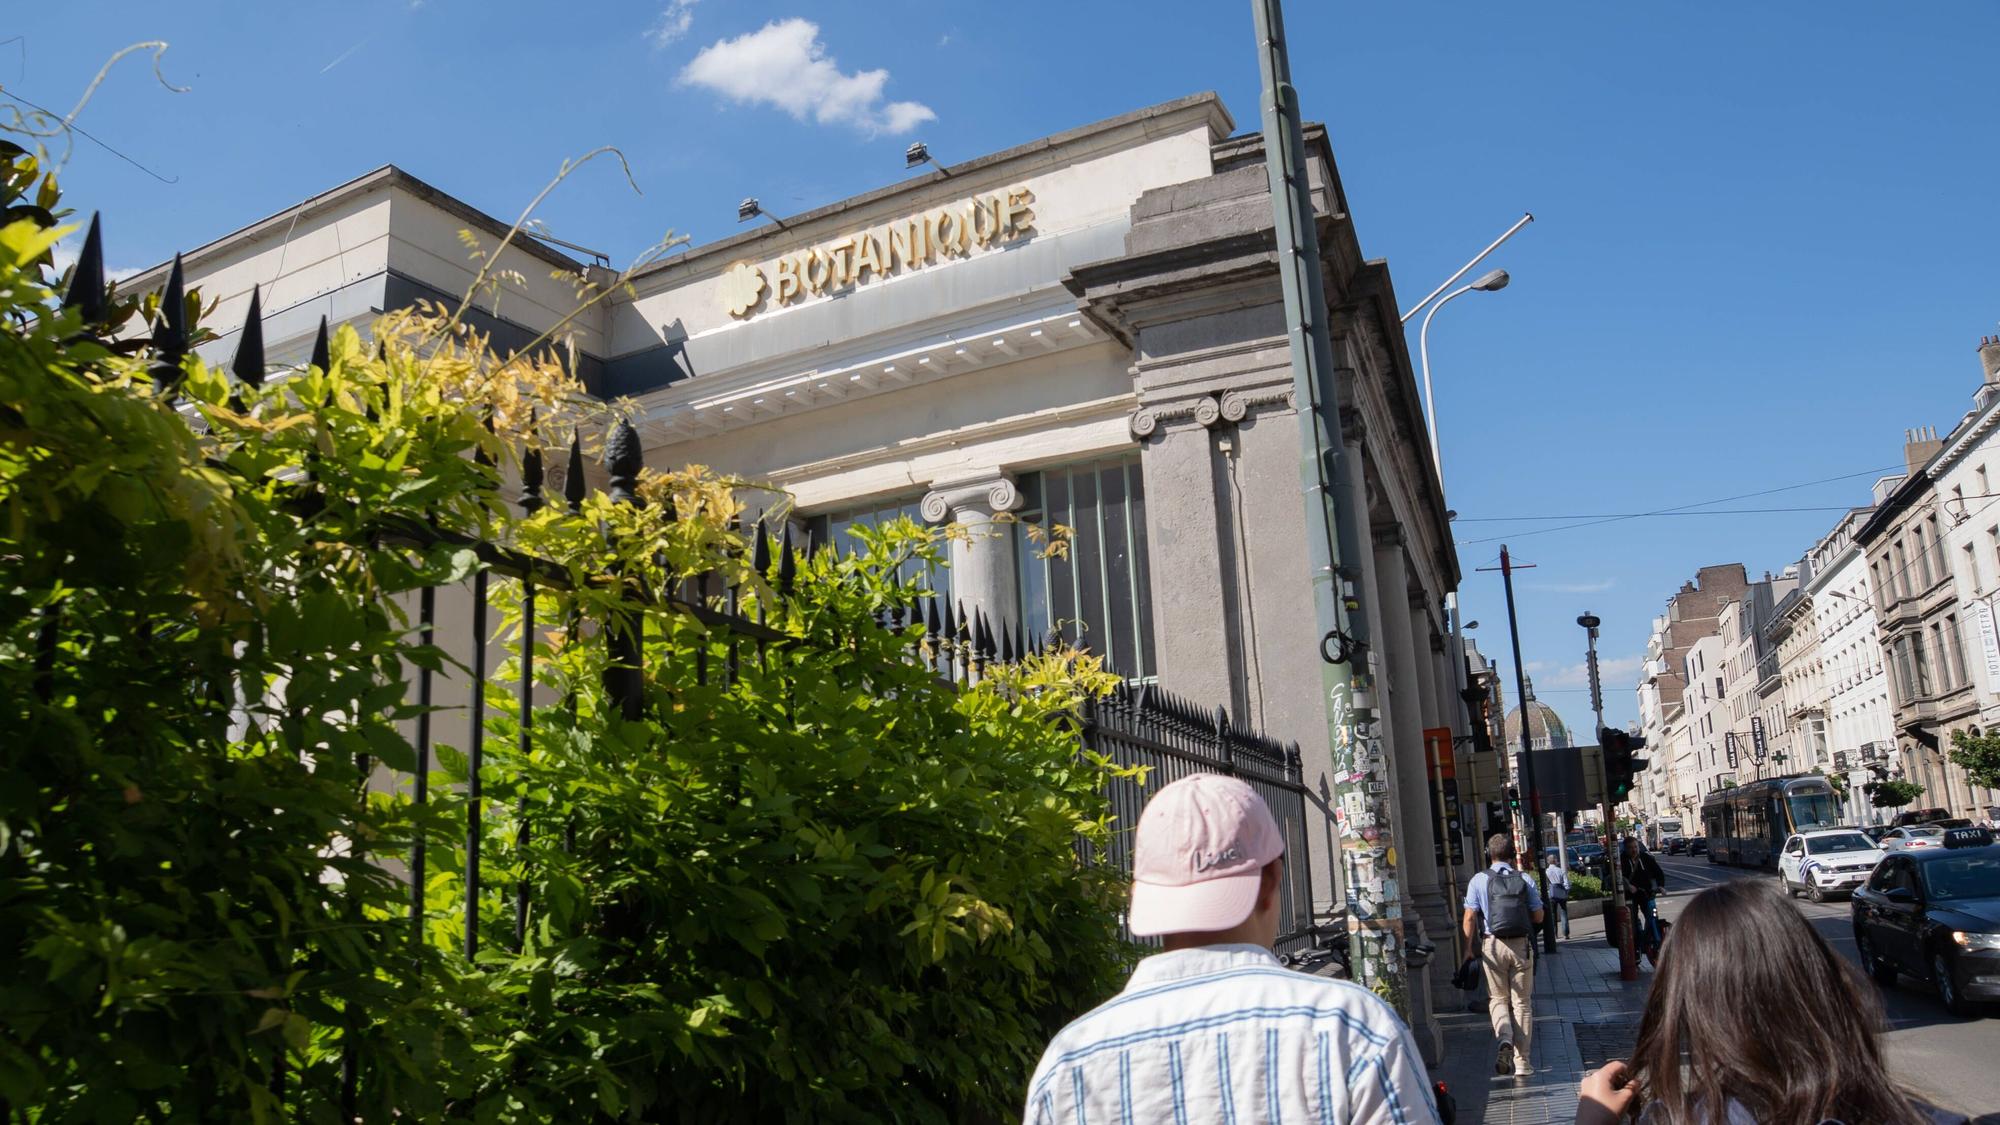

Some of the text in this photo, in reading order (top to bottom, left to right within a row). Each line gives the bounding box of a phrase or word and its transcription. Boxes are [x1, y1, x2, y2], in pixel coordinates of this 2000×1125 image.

[775, 186, 1034, 304] BOTANIQUE
[1987, 649, 1999, 676] HOTEL
[1953, 829, 1982, 840] TAXI
